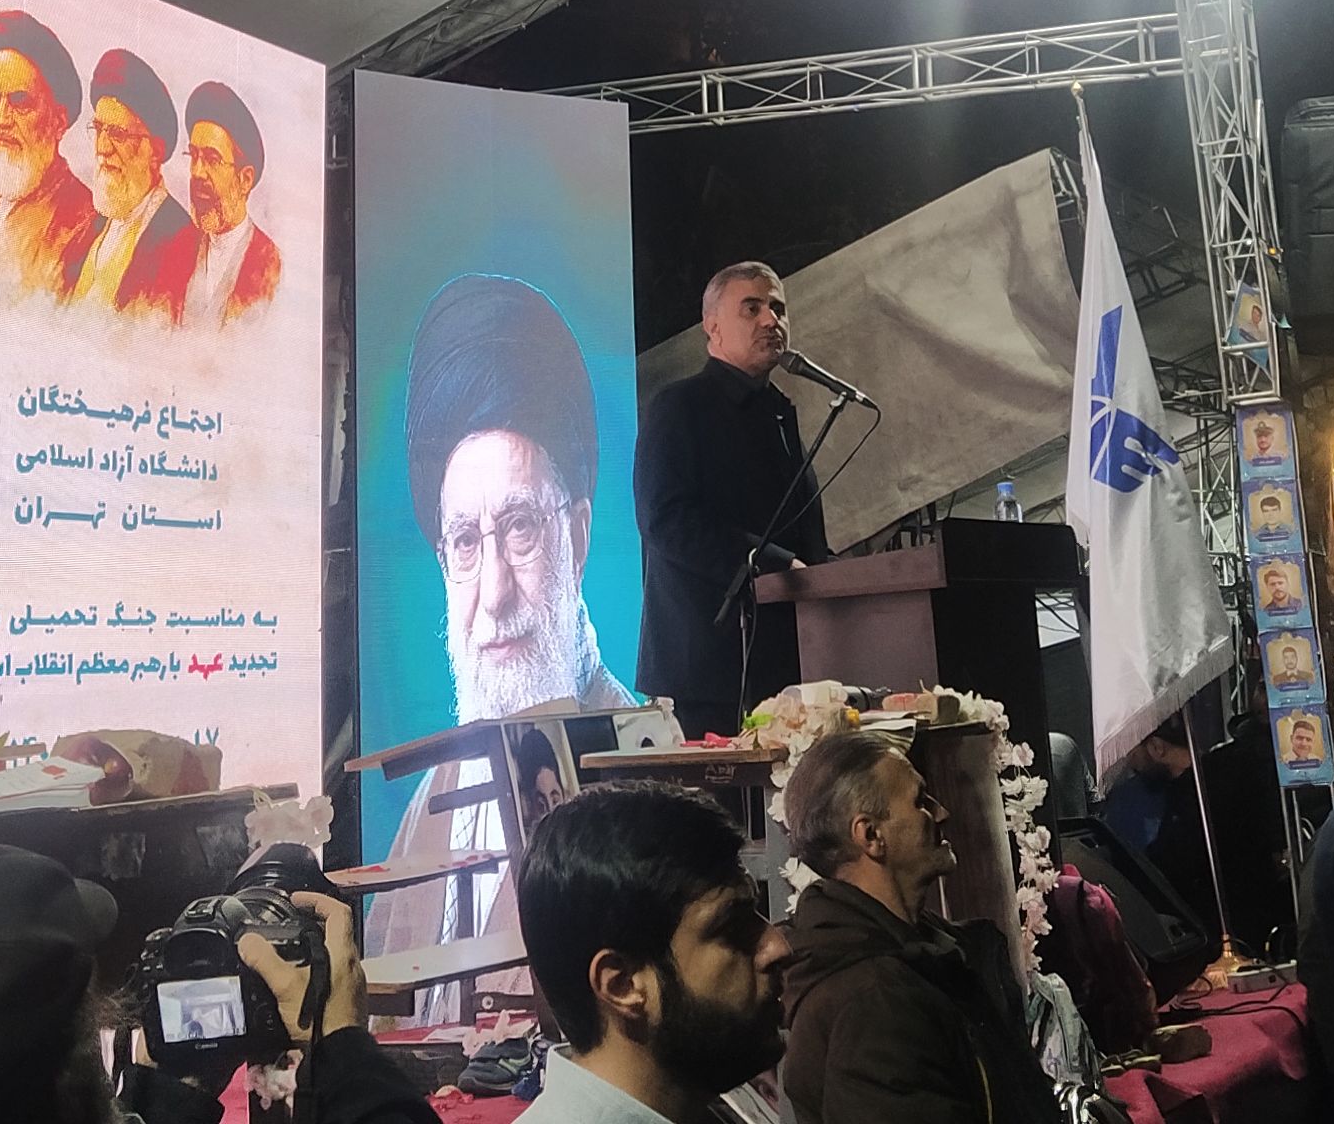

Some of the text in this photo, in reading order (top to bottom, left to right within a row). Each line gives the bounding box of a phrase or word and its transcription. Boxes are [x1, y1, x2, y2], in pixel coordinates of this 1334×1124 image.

[17, 385, 223, 440] اجتماع فرهیختگان
[16, 444, 218, 482] دانشگاه آزاد اسلامی
[14, 495, 222, 530] استان تهران
[9, 604, 98, 635] تحمیلی
[107, 602, 157, 634] جنگ
[166, 609, 246, 635] مناسبت
[252, 611, 278, 634] به
[14, 652, 74, 684] انقلاب
[76, 651, 130, 685] معظم
[187, 653, 224, 681] عهد
[228, 652, 278, 678] تجدید
